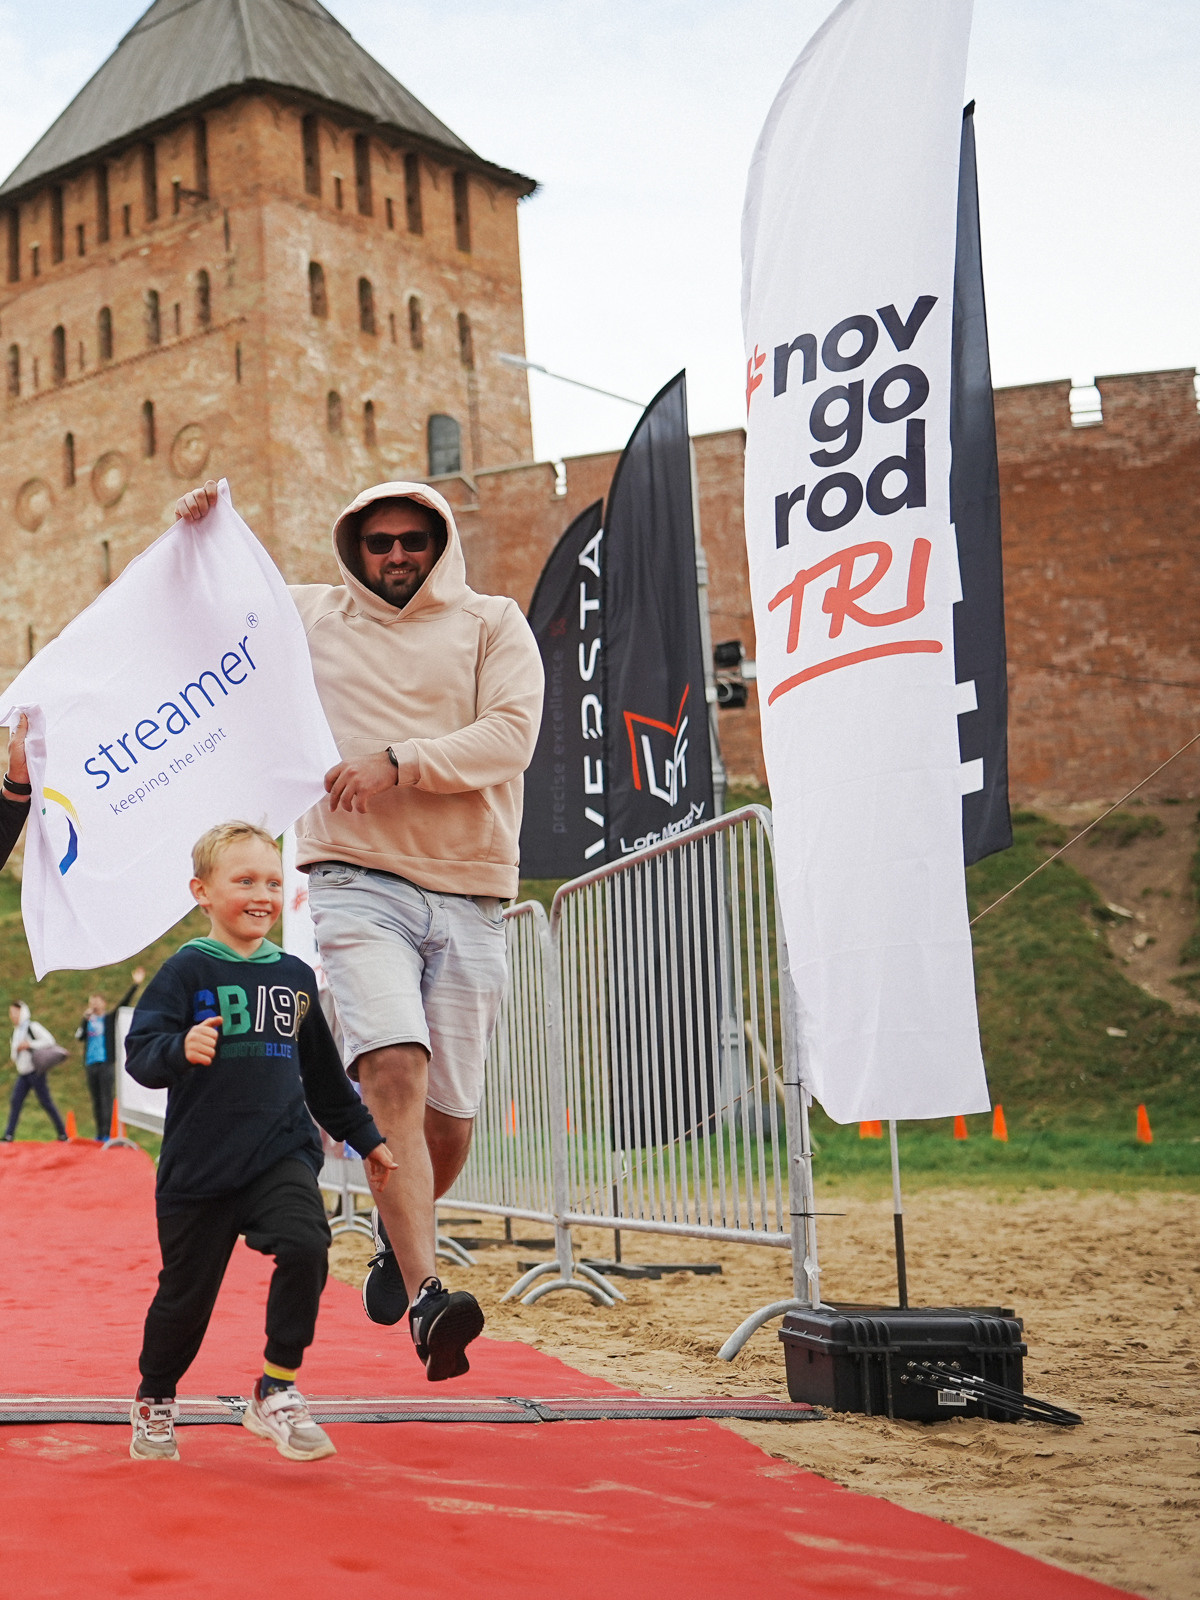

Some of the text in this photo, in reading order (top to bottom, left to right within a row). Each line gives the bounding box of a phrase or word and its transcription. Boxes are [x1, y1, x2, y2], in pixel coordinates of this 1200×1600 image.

[809, 363, 930, 467] go
[774, 418, 927, 549] rod
[767, 537, 932, 654] TRI
[109, 727, 227, 816] keeping the light
[551, 650, 566, 835] precise excellence
